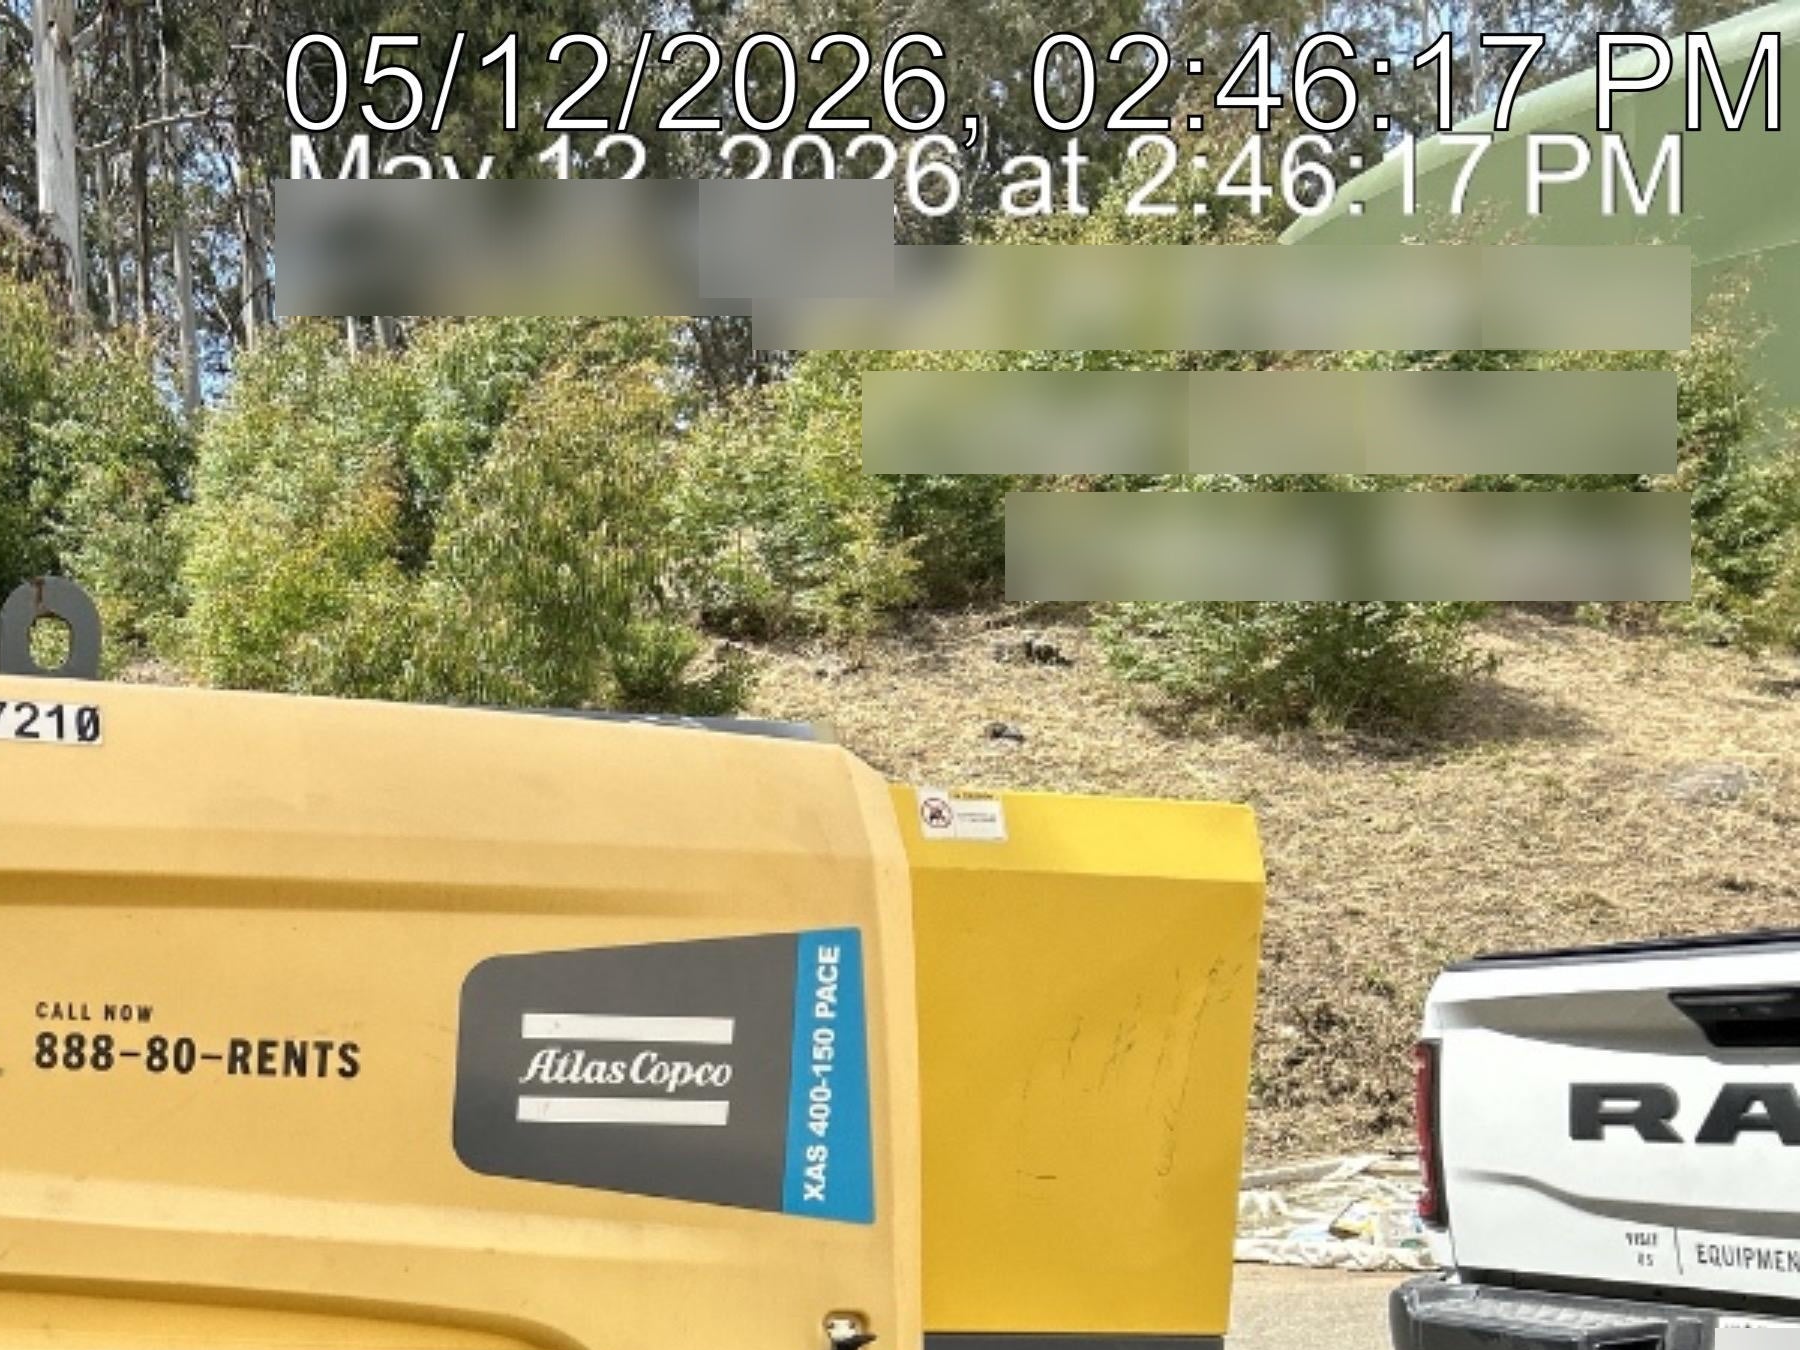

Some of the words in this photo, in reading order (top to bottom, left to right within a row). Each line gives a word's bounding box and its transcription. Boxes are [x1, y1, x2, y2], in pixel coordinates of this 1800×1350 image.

[814, 944, 842, 1019] PACE
[35, 1001, 92, 1022] CALL
[103, 1003, 154, 1024] NOW
[33, 1031, 361, 1080] 888-80-RENTS
[808, 1027, 836, 1138] 400-150
[803, 1145, 830, 1202] XAS
